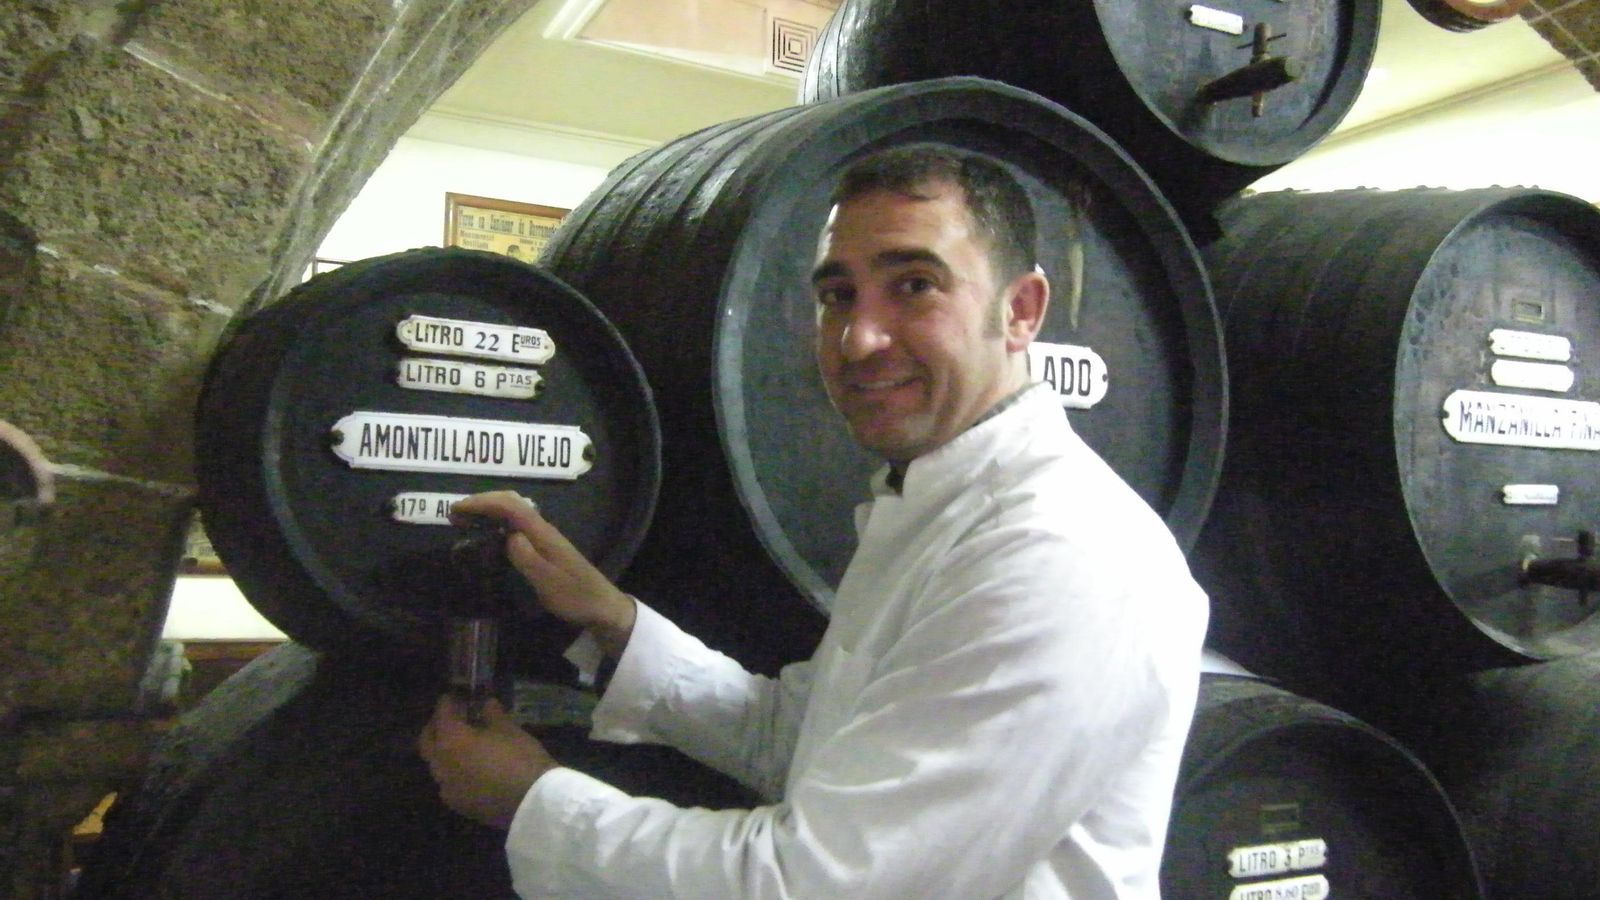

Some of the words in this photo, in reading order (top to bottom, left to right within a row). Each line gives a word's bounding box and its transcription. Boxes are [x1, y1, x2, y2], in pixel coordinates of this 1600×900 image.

[414, 322, 464, 347] LITRO
[474, 331, 500, 352] 22
[406, 364, 461, 385] LITRO
[474, 370, 485, 388] 6
[1043, 355, 1091, 397] ADO
[1458, 400, 1562, 439] MANZANILLA
[359, 422, 505, 465] AMONTILLADO
[517, 433, 571, 468] VIEJO
[1239, 850, 1277, 873] LITRO
[1283, 848, 1292, 868] 3
